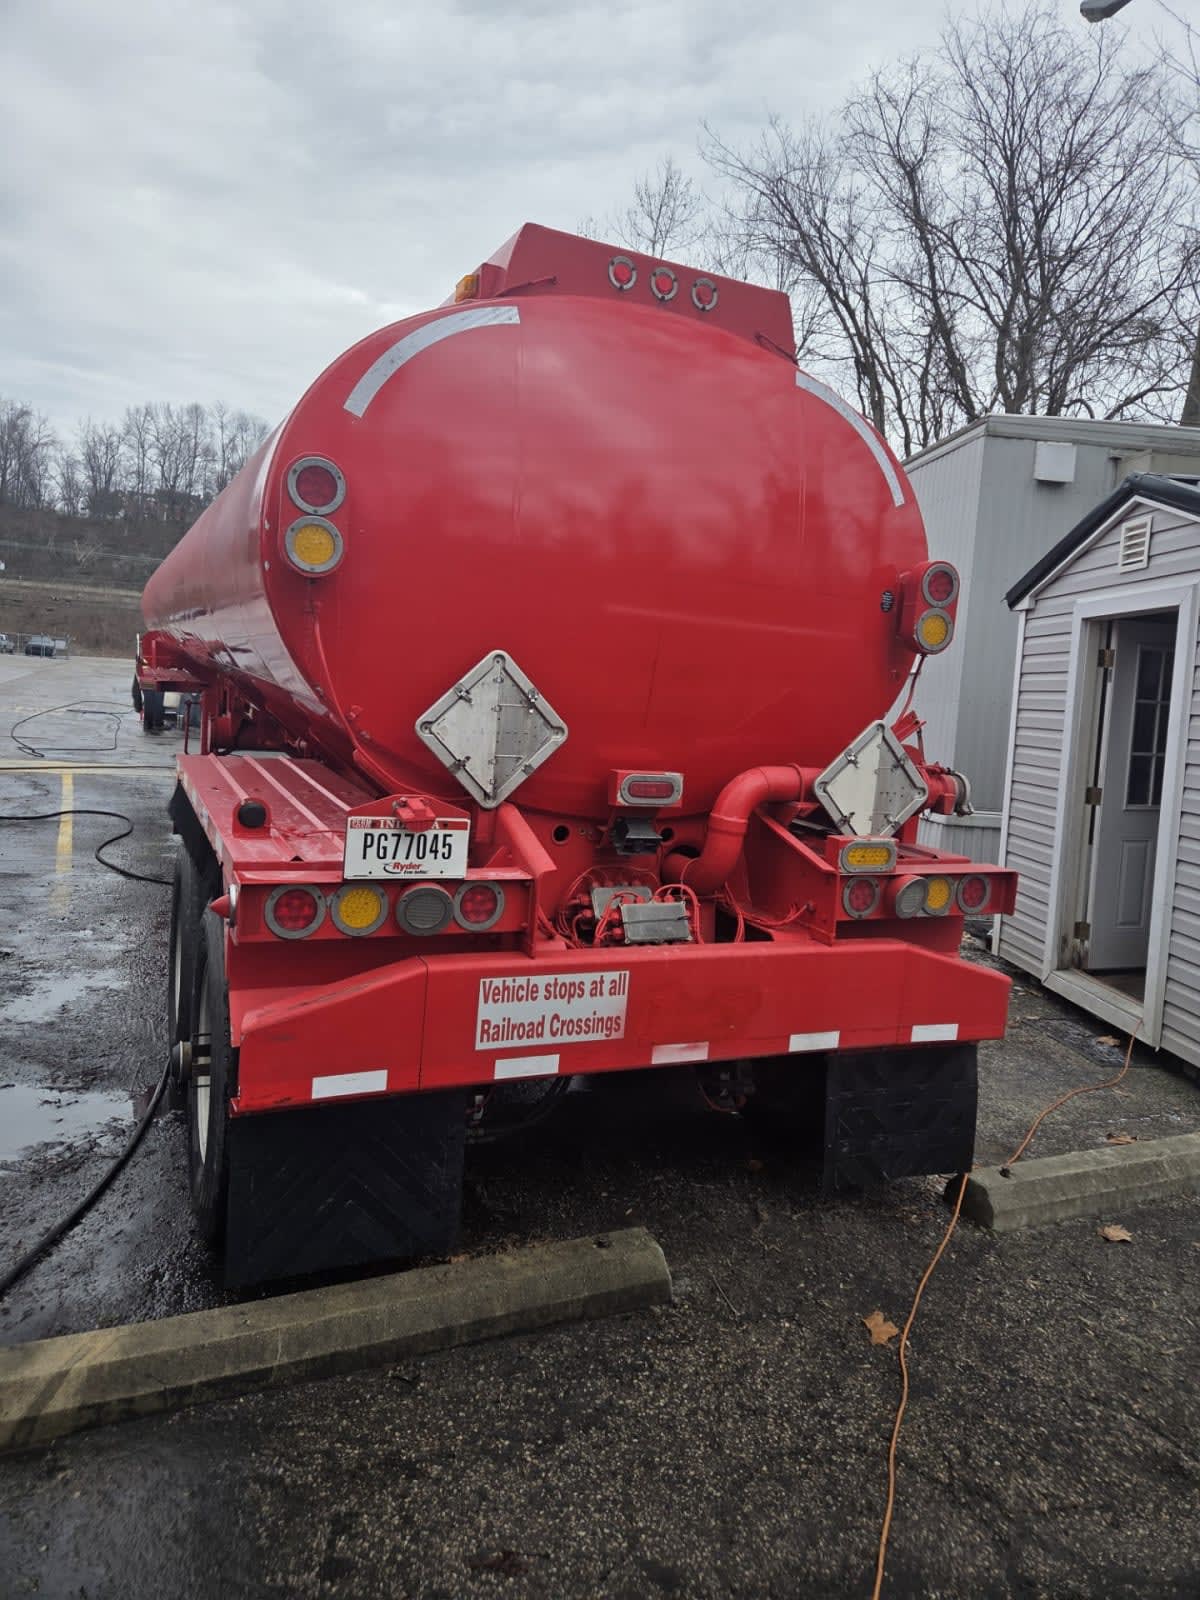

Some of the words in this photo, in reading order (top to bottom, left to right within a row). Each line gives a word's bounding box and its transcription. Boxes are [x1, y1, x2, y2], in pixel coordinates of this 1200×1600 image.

[362, 832, 453, 860] PG77045
[392, 862, 422, 872] Ryder
[482, 978, 539, 1004] Vehicle
[544, 977, 585, 1004] stops
[589, 975, 604, 998] at
[609, 973, 627, 996] all
[480, 1014, 546, 1043] Railroad
[550, 1010, 622, 1037] Crossings
